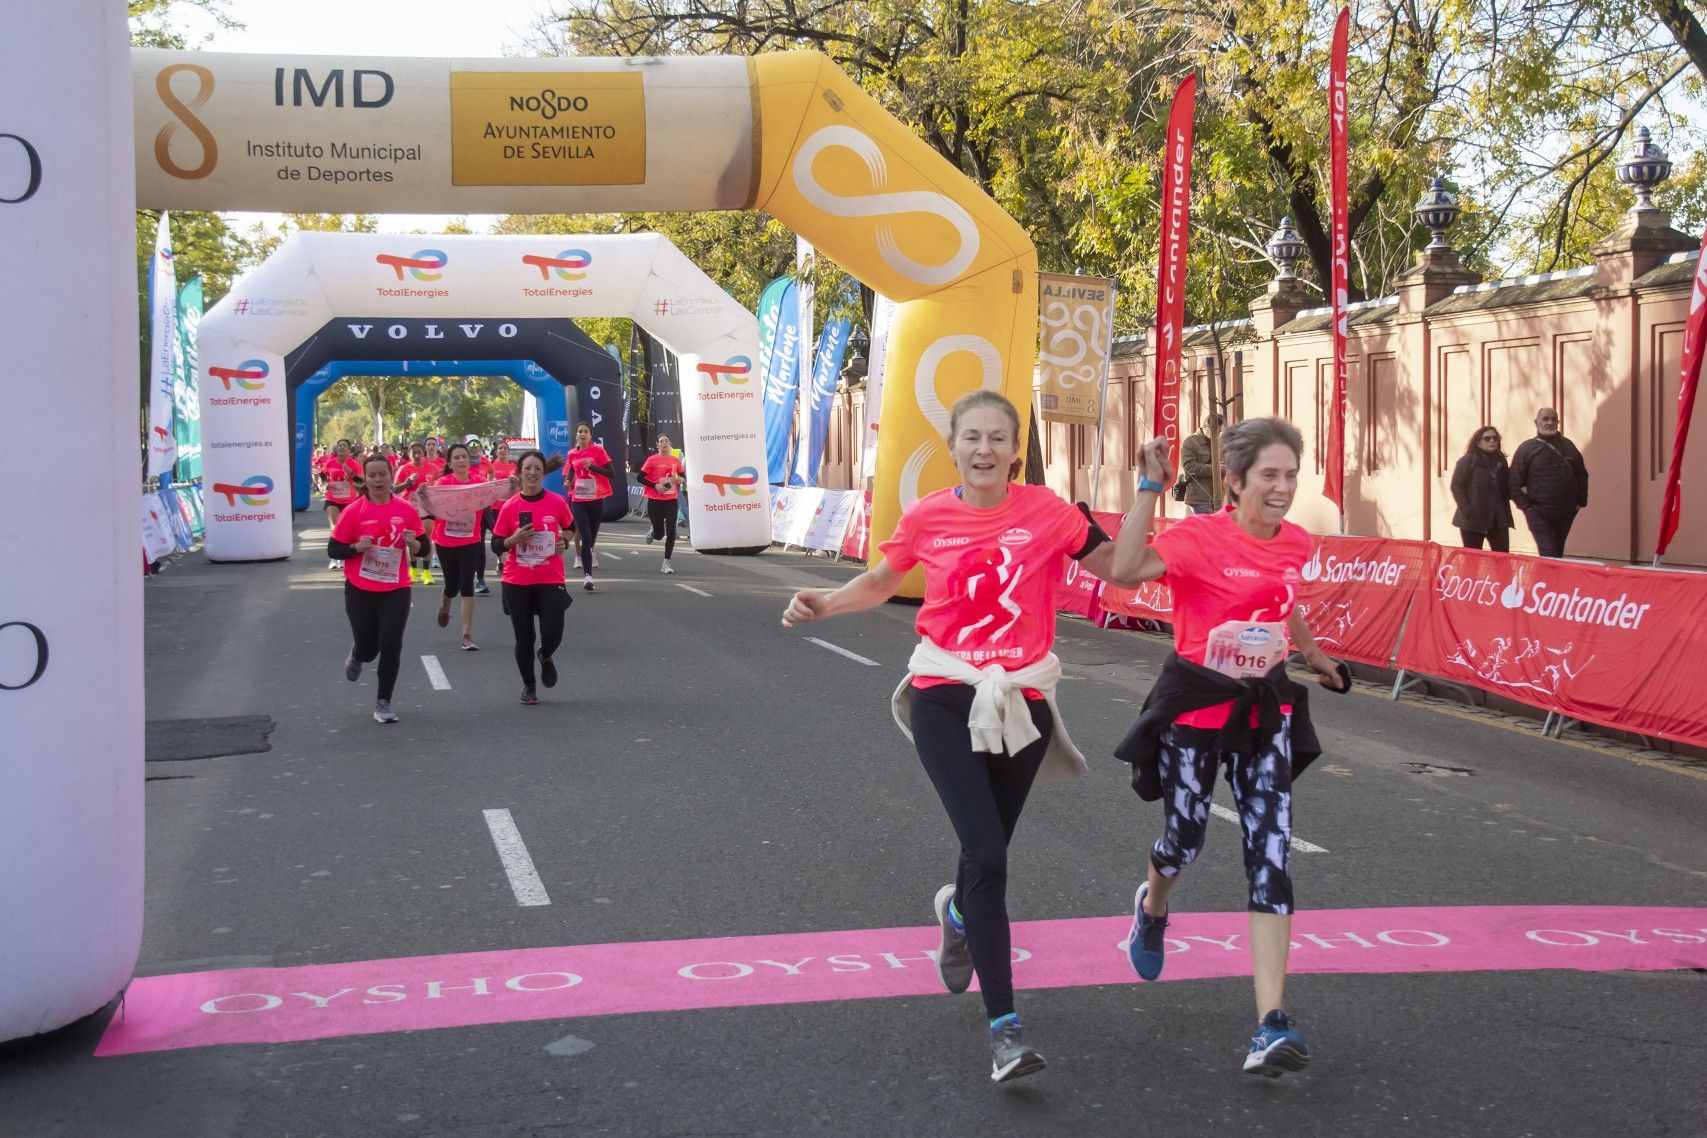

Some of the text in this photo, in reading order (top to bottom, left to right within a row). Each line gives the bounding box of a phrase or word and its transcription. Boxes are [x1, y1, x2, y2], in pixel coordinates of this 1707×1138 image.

[275, 68, 394, 108] IMD
[247, 140, 421, 163] Instituto Municipal
[504, 145, 525, 159] DE
[278, 166, 394, 184] de Deportes
[377, 288, 449, 299] TotalEnergies
[522, 287, 594, 298] TotalEnergies
[347, 323, 518, 340] VOLVO
[766, 324, 798, 405] Marlene
[811, 326, 840, 411] Marlene
[209, 397, 272, 407] TotalEnergies
[699, 390, 754, 401] TotalEnergies
[700, 433, 757, 442] totalenergies.es
[705, 502, 762, 512] TotalEnergies
[214, 512, 276, 523] TotalEnergies
[933, 536, 971, 548] OYSHO
[1223, 567, 1261, 578] OYSHO
[1322, 555, 1406, 587] Santander
[1435, 563, 1650, 630] Sports Santander
[1236, 655, 1266, 669] 016
[1117, 929, 1450, 954] OYHO
[1525, 929, 1707, 946] OYS
[200, 971, 583, 1013] OYSHO
